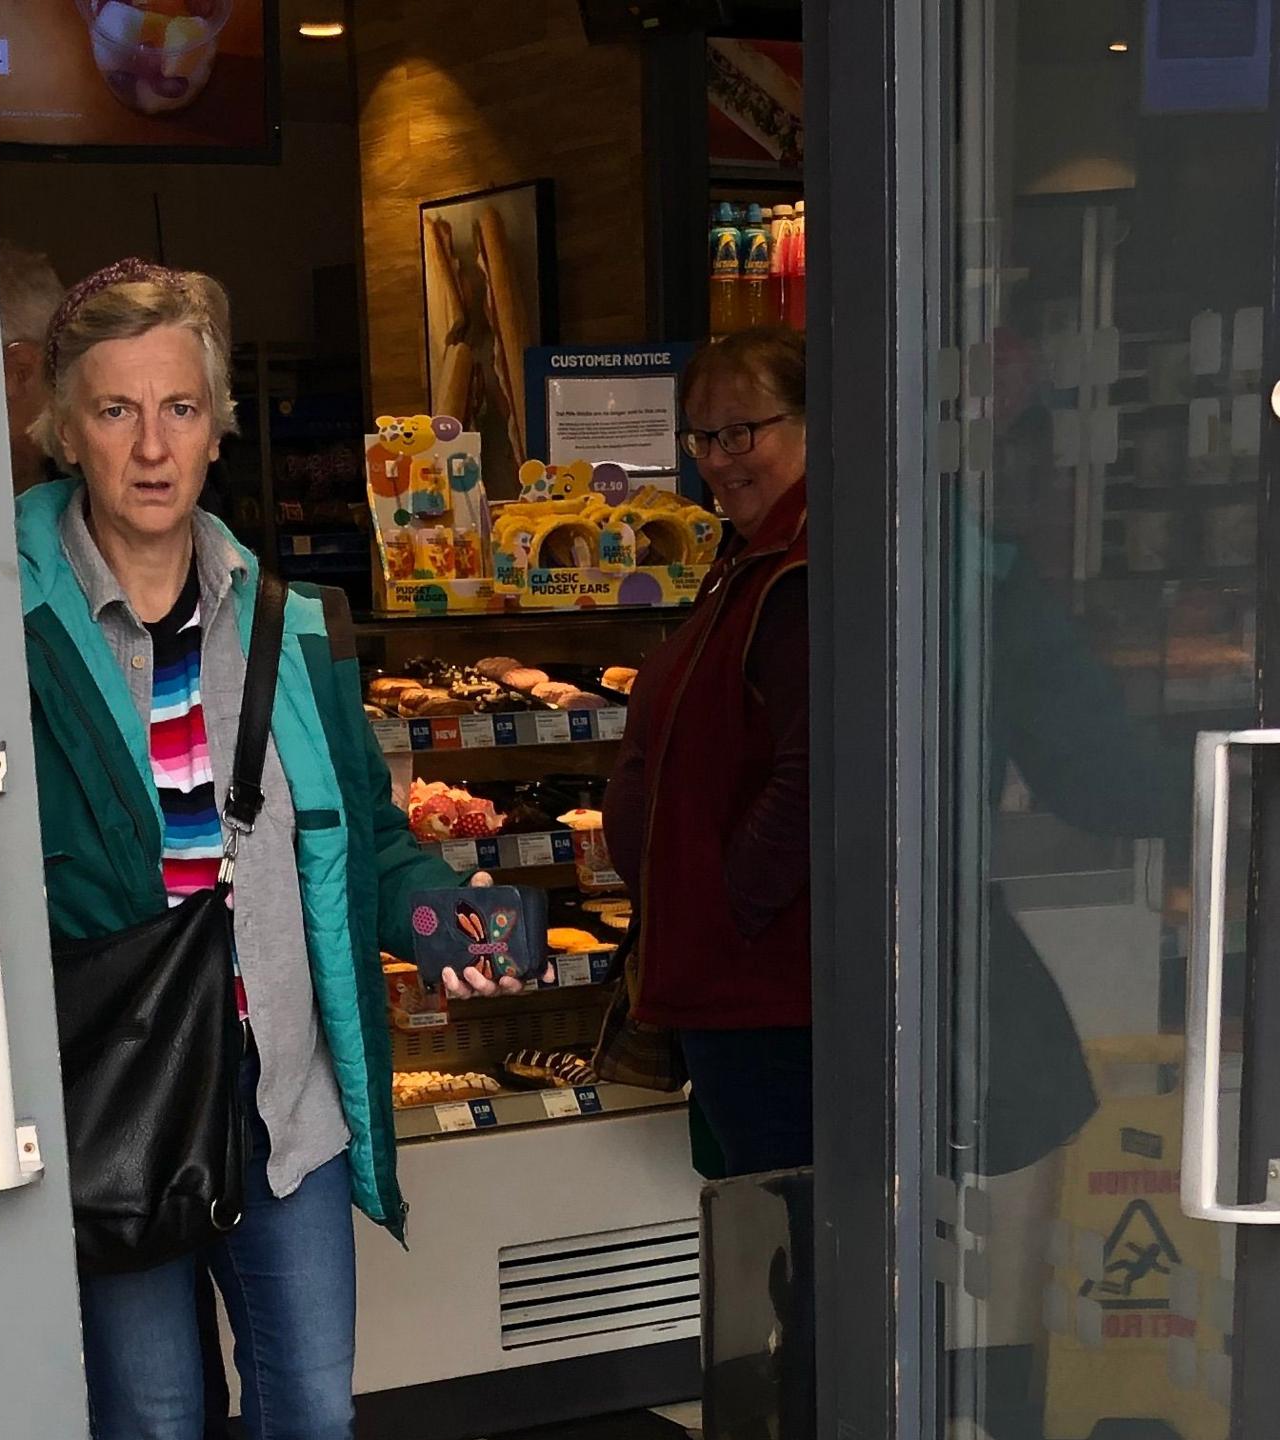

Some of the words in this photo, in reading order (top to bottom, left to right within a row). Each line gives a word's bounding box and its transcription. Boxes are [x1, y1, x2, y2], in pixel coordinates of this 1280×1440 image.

[551, 354, 622, 368] CUSTOMER
[624, 352, 672, 366] NOTICE
[531, 572, 580, 585] CLASSIC
[531, 583, 578, 596] PUDSEY
[579, 583, 611, 594] EARS
[434, 729, 457, 741] NEW
